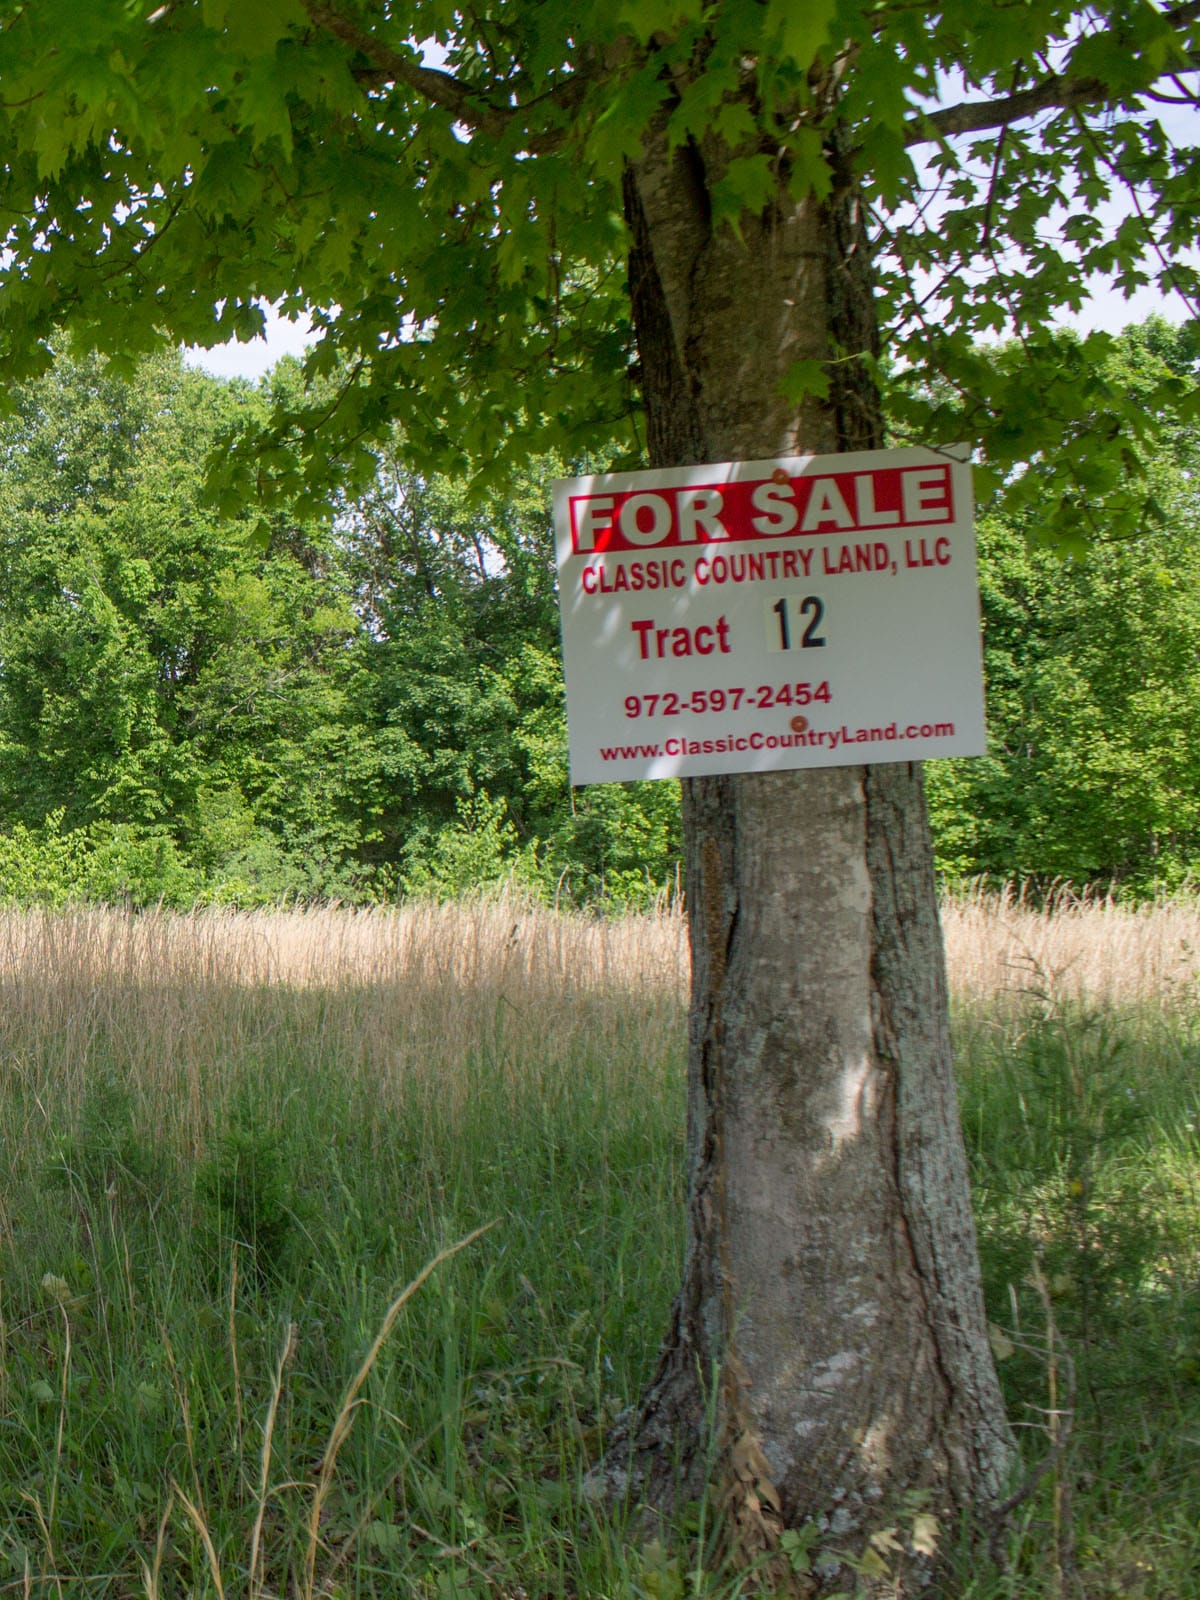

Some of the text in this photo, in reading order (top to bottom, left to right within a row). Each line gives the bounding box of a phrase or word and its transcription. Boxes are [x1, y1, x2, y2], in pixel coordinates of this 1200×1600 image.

[576, 468, 950, 551] FOR SALE
[582, 537, 951, 594] CLASSIC COUNTRY LAND, LLC
[631, 596, 826, 659] Tract 12
[624, 681, 832, 719] 972-597-2454
[600, 721, 955, 761] www.ClassicCountryLand.com
